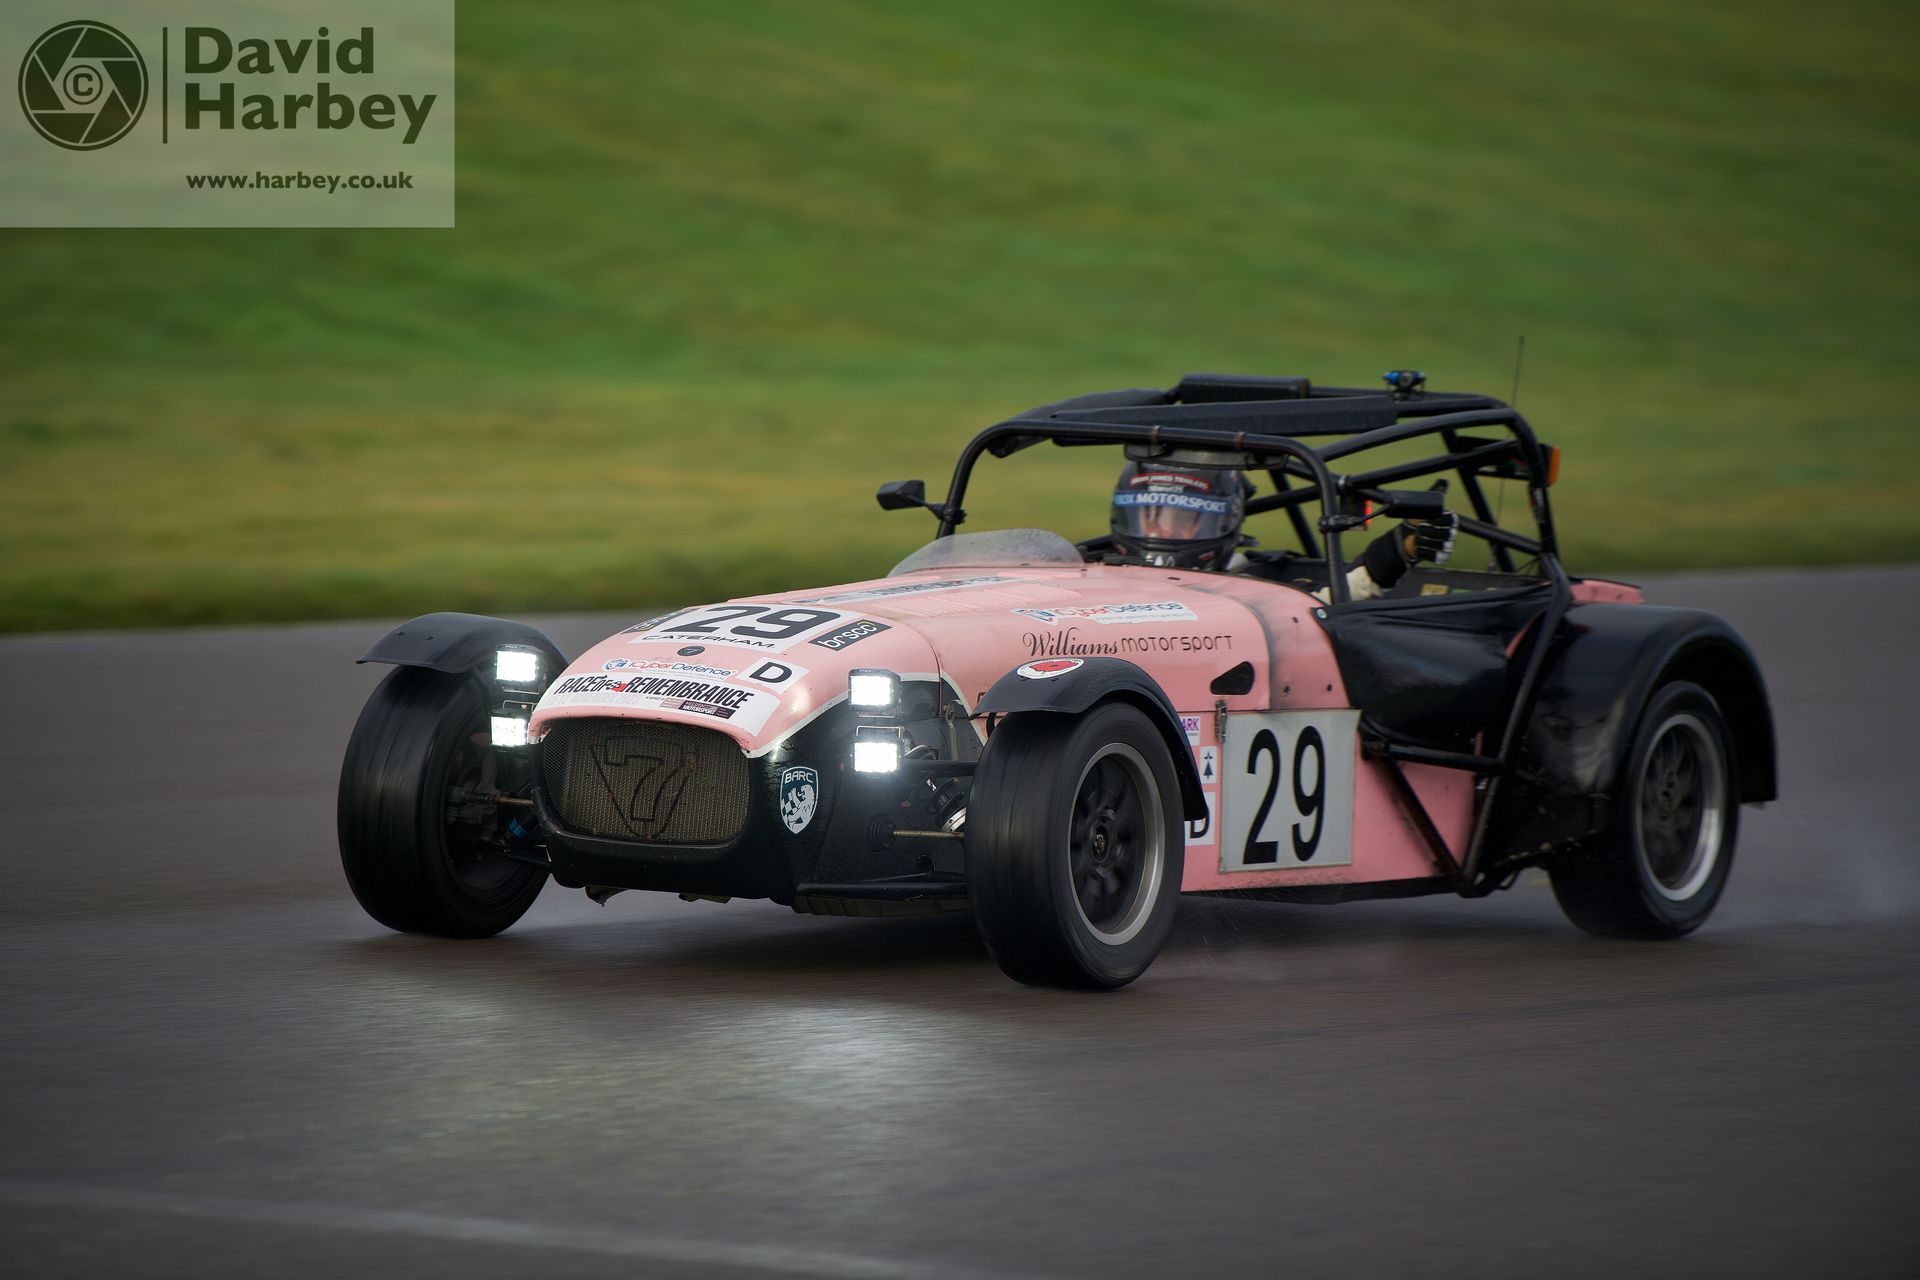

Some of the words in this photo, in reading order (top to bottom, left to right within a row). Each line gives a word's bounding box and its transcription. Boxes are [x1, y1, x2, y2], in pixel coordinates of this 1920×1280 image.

[1136, 492, 1227, 513] MOTORSPORT
[660, 605, 842, 640] 29
[642, 634, 775, 649] CATERHAM
[817, 620, 878, 650] brscc
[1022, 626, 1118, 657] Williams
[628, 659, 732, 677] iCyberDefence
[749, 661, 793, 685] D
[554, 675, 601, 695] RACE
[625, 676, 755, 709] REMEMBRANCE
[1181, 718, 1200, 731] ARK
[785, 770, 814, 783] BARC
[1243, 725, 1326, 865] 29
